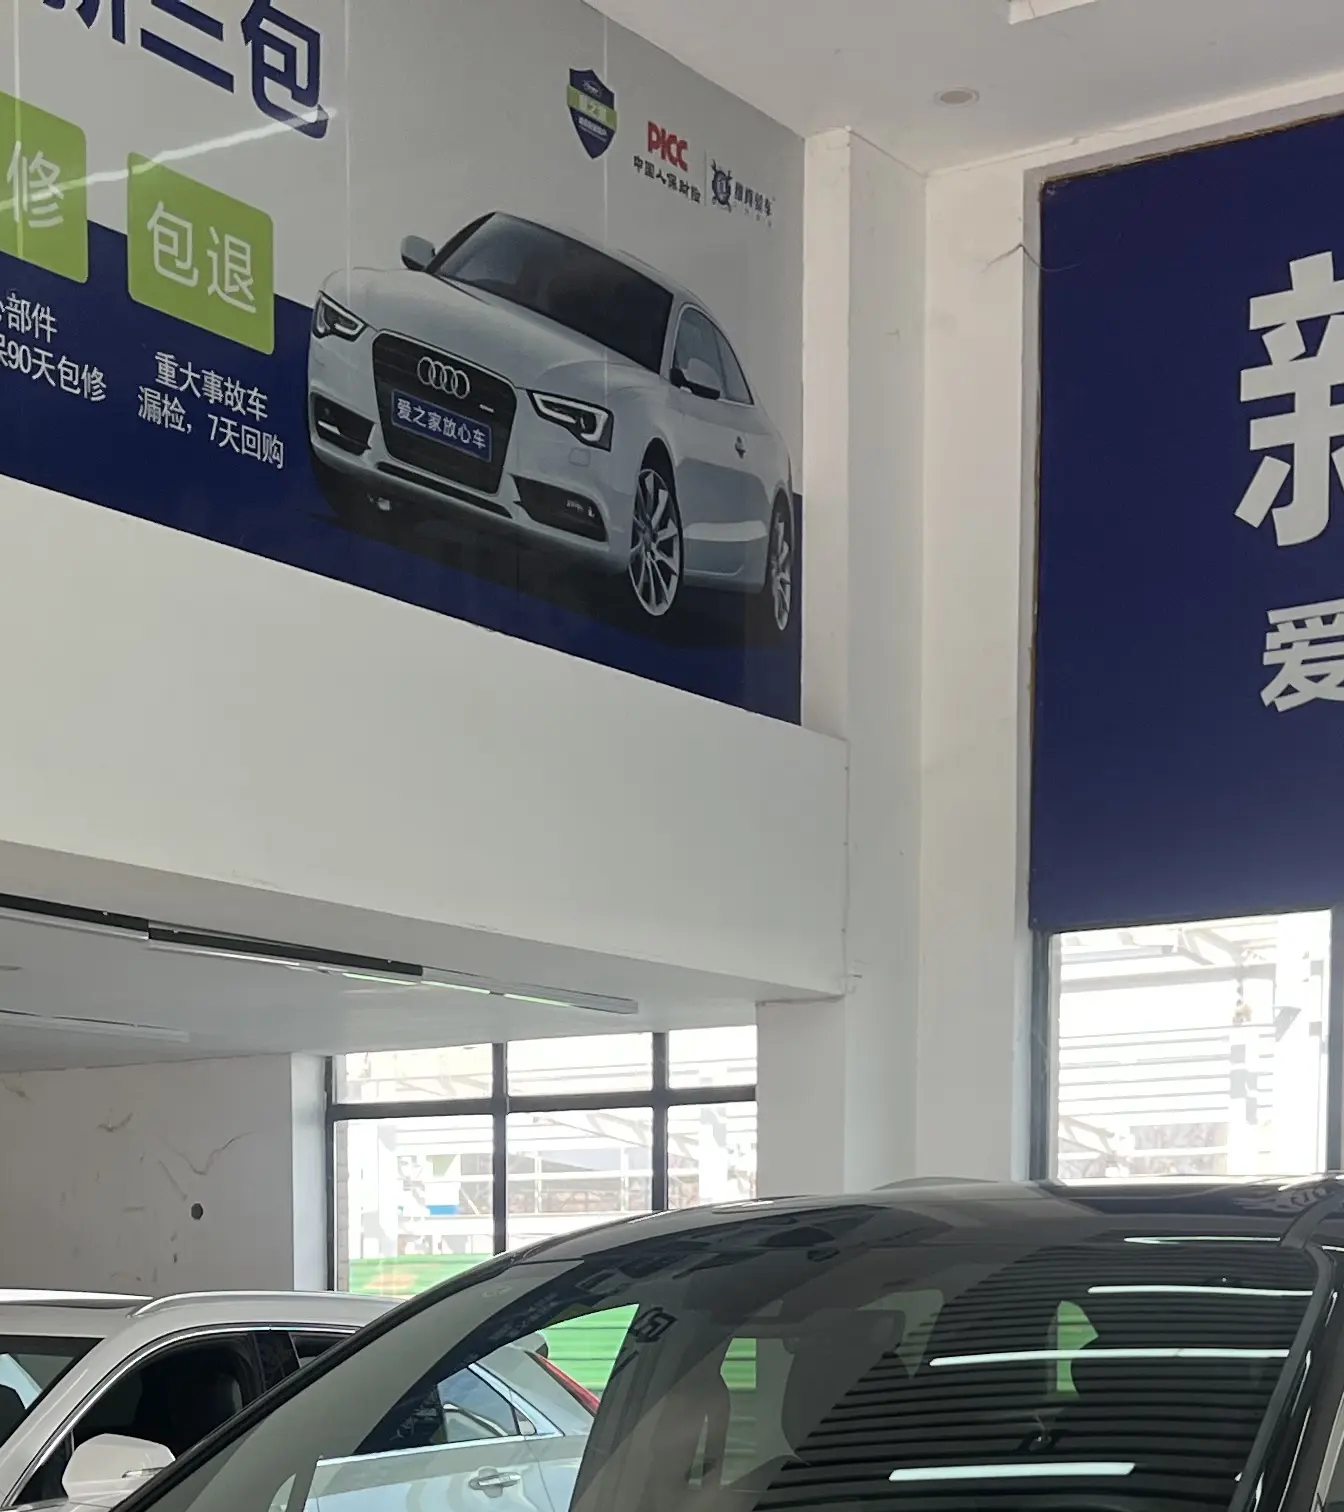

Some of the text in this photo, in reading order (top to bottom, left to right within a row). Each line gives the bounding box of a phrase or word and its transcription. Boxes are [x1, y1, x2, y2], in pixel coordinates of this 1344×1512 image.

[42, 0, 329, 139] 三包
[647, 120, 689, 172] PICC
[147, 200, 257, 314] 包退
[155, 351, 268, 422] 重大事故车
[397, 398, 486, 449] 爱之家放心车
